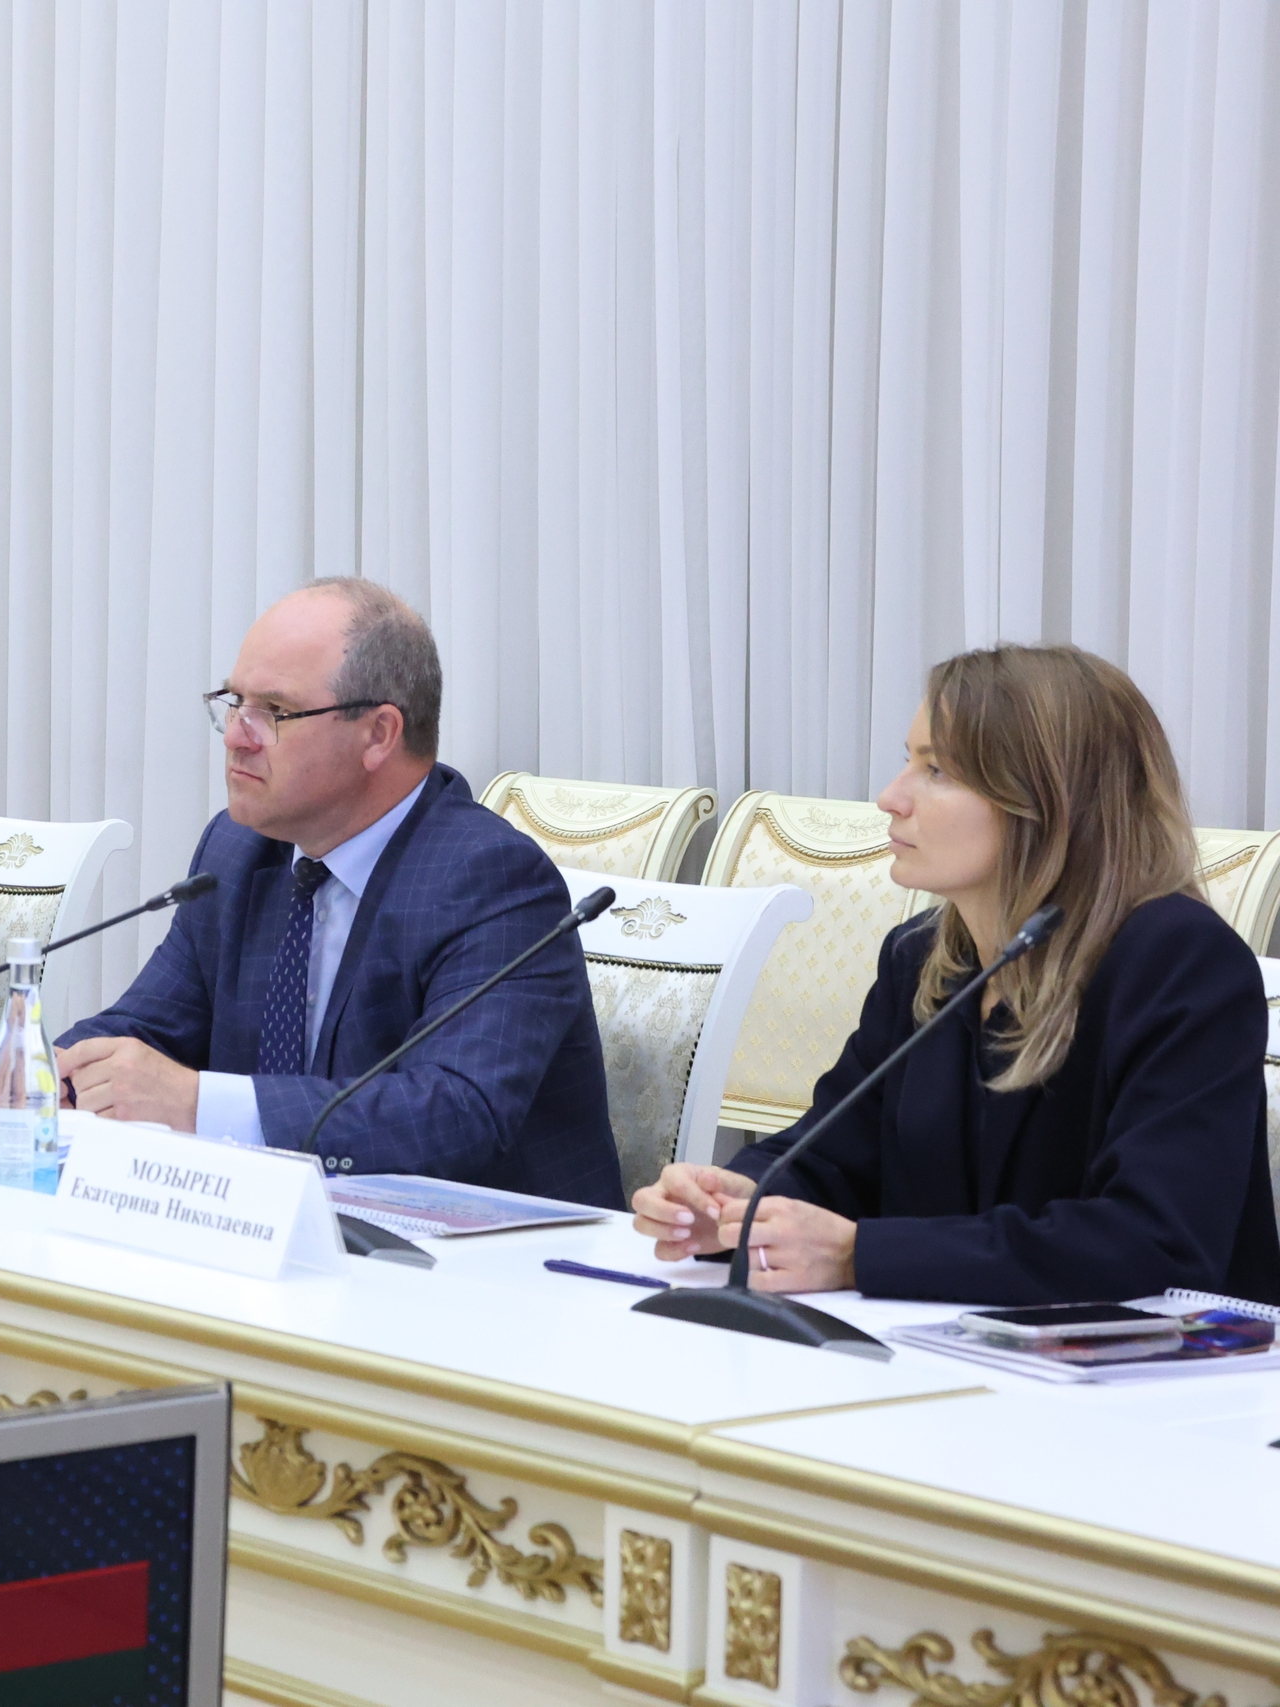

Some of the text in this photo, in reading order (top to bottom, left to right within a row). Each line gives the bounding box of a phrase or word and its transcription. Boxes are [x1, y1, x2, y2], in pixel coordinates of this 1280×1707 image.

[127, 1158, 232, 1201] МОЗЫРЕЦ
[71, 1177, 274, 1241] Екатерина Николаевна
